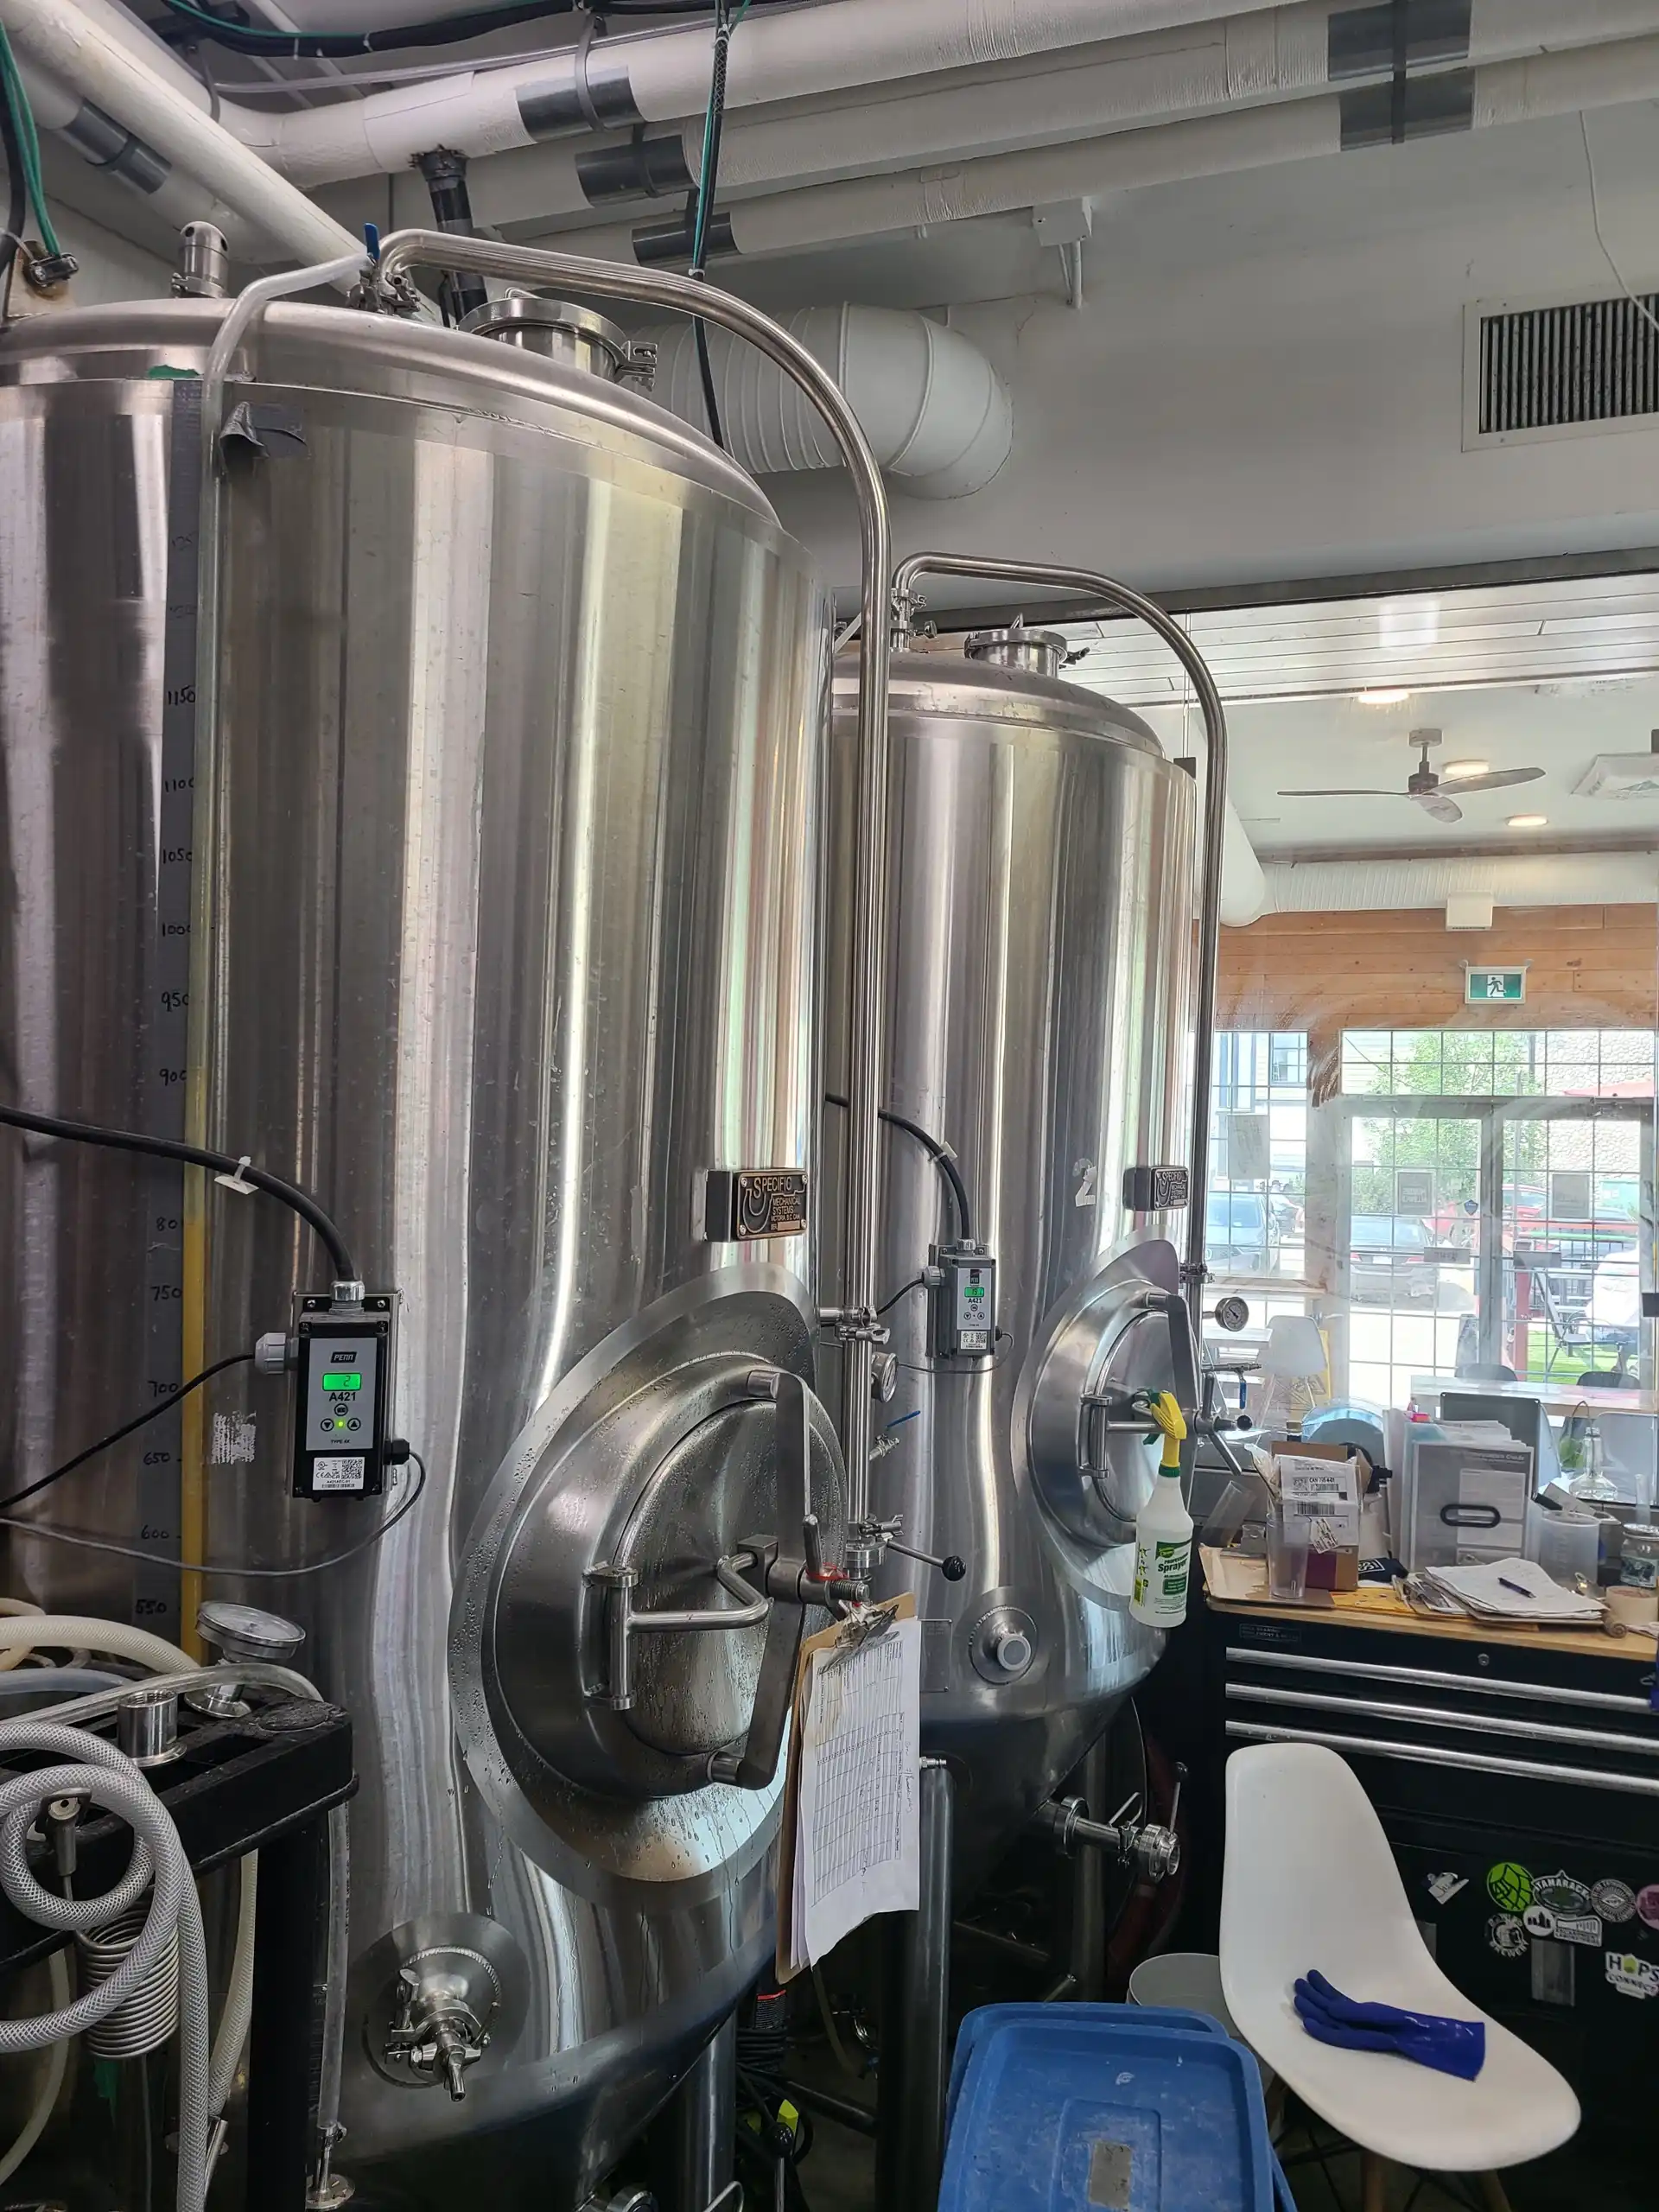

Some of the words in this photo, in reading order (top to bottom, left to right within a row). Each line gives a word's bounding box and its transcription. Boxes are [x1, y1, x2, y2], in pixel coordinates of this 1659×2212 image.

[168, 685, 196, 706] 1150
[753, 1176, 792, 1199] SPECIFIC
[1072, 1158, 1097, 1207] 2
[772, 1196, 801, 1206] MECHANICAL
[772, 1205, 794, 1216] SYSTEMS
[150, 1285, 182, 1301] 750
[148, 1380, 179, 1397] 700
[328, 1392, 356, 1402] A421
[143, 1452, 171, 1465] 650
[141, 1524, 169, 1539] 600
[1158, 1558, 1187, 1573] Sprayer
[136, 1599, 167, 1615] 550
[1534, 1878, 1591, 1900] TAMARACK
